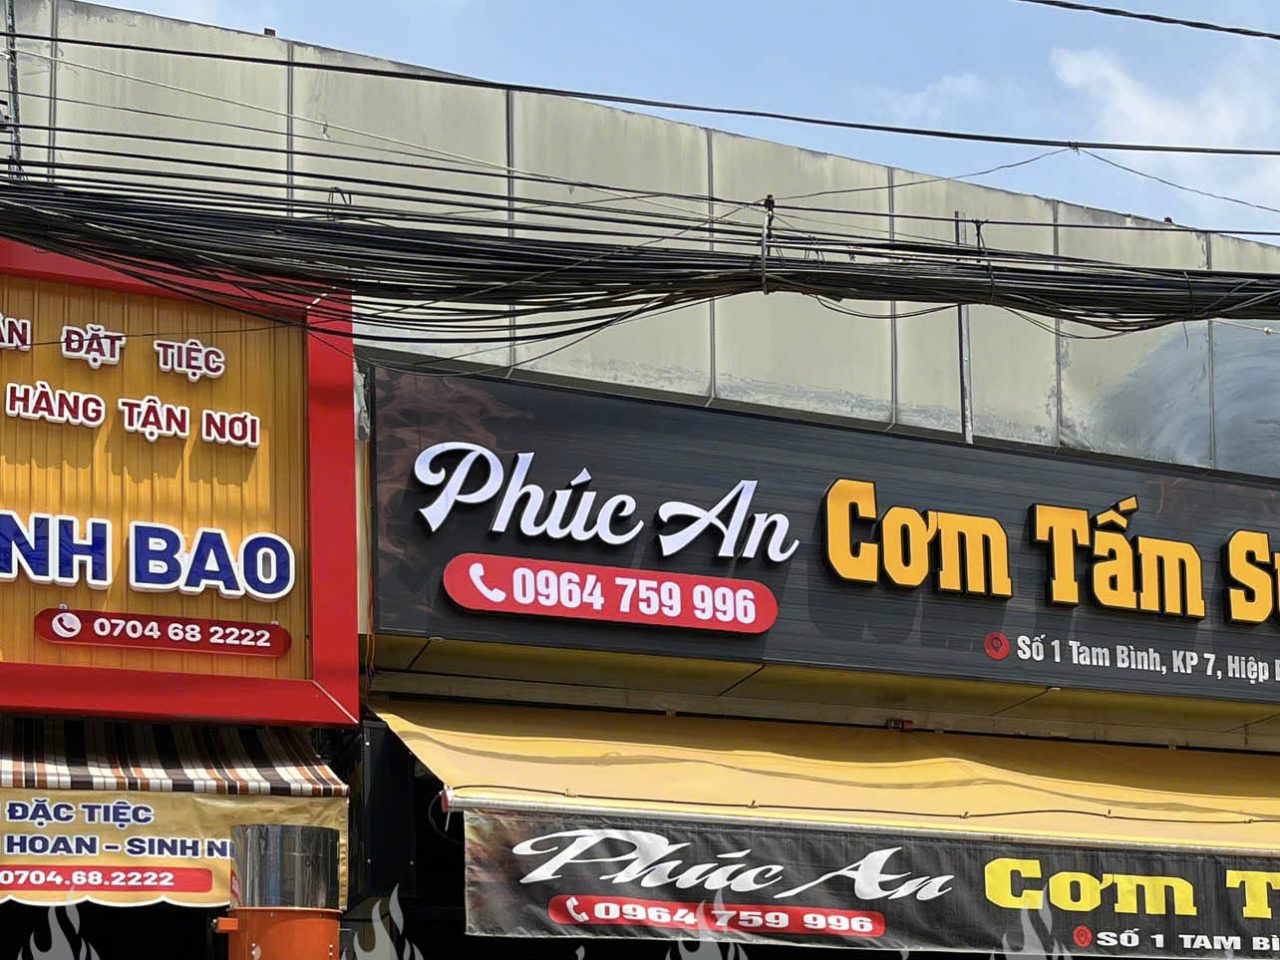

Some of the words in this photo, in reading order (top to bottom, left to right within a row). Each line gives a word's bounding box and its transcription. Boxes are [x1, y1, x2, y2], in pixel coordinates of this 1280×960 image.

[61, 325, 125, 369] ĐẶT
[154, 340, 226, 381] TIỆC
[6, 382, 105, 425] HÀNG
[118, 398, 190, 442] TẬN
[202, 409, 260, 446] NƠI
[412, 440, 645, 546] Phúc
[657, 479, 800, 563] An
[129, 519, 295, 599] BAO
[825, 477, 1013, 599] Cơm
[1031, 493, 1207, 621] Tấm
[512, 566, 604, 611] 0964
[615, 576, 681, 616] 759
[693, 583, 757, 624] 996
[94, 617, 161, 640] 0704
[167, 621, 202, 642] 68
[209, 626, 271, 647] 2222
[1017, 632, 1045, 661] Số
[1051, 640, 1060, 663] 1
[1068, 640, 1110, 668] Tam
[1116, 644, 1166, 676] Bình,
[1172, 651, 1198, 674] KP
[1204, 653, 1222, 679] 7,
[1227, 655, 1269, 685] Hiệp
[7, 798, 75, 828] ĐẶC
[82, 801, 154, 828] TIỆC
[6, 835, 98, 855] HOAN
[127, 838, 204, 857] SINH
[512, 828, 784, 892] Phúc
[773, 846, 955, 902] An
[0, 870, 175, 886] 0704.68.2222
[983, 857, 1198, 917] Cơm
[593, 901, 698, 926] 0964
[711, 908, 790, 929] 759
[802, 913, 874, 934] 996
[1096, 927, 1141, 948] SỐ
[1150, 934, 1165, 949] 1
[1179, 934, 1241, 951] TAM
